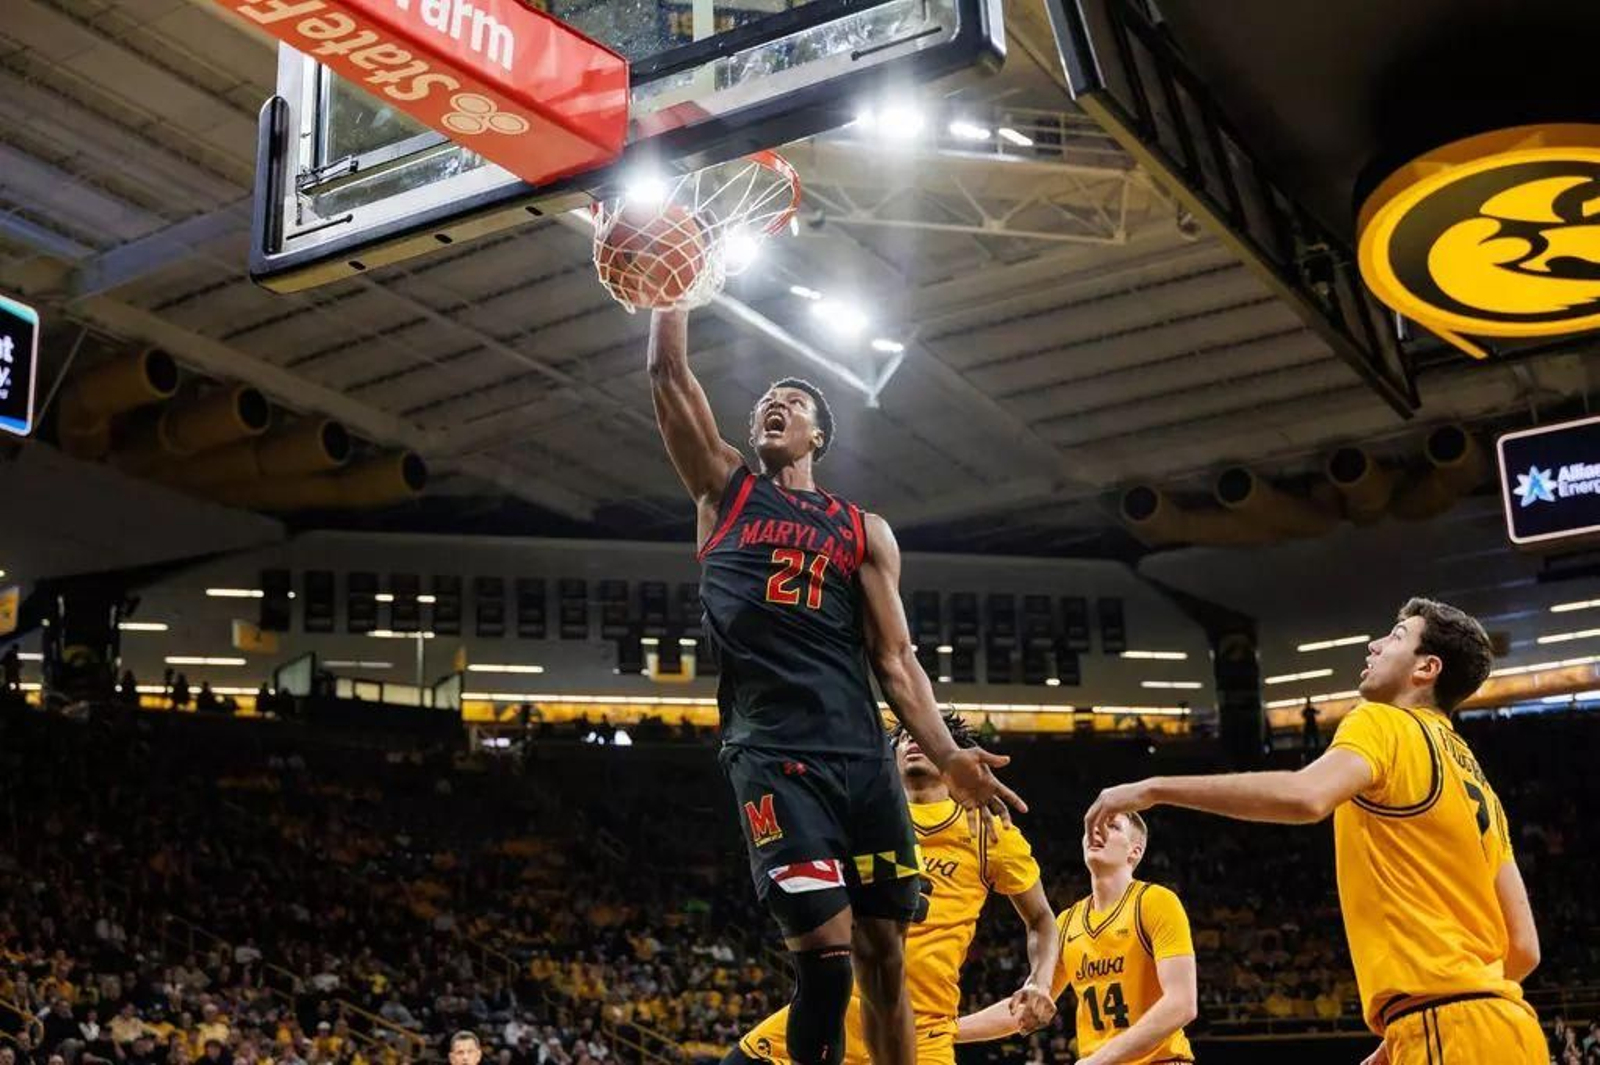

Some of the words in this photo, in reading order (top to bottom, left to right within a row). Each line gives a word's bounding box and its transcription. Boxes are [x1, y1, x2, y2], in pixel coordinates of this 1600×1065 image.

[396, 0, 515, 71] arm
[766, 548, 830, 610] 21
[744, 794, 782, 842] M
[1076, 952, 1125, 981] Iowa
[1082, 982, 1130, 1031] 14
